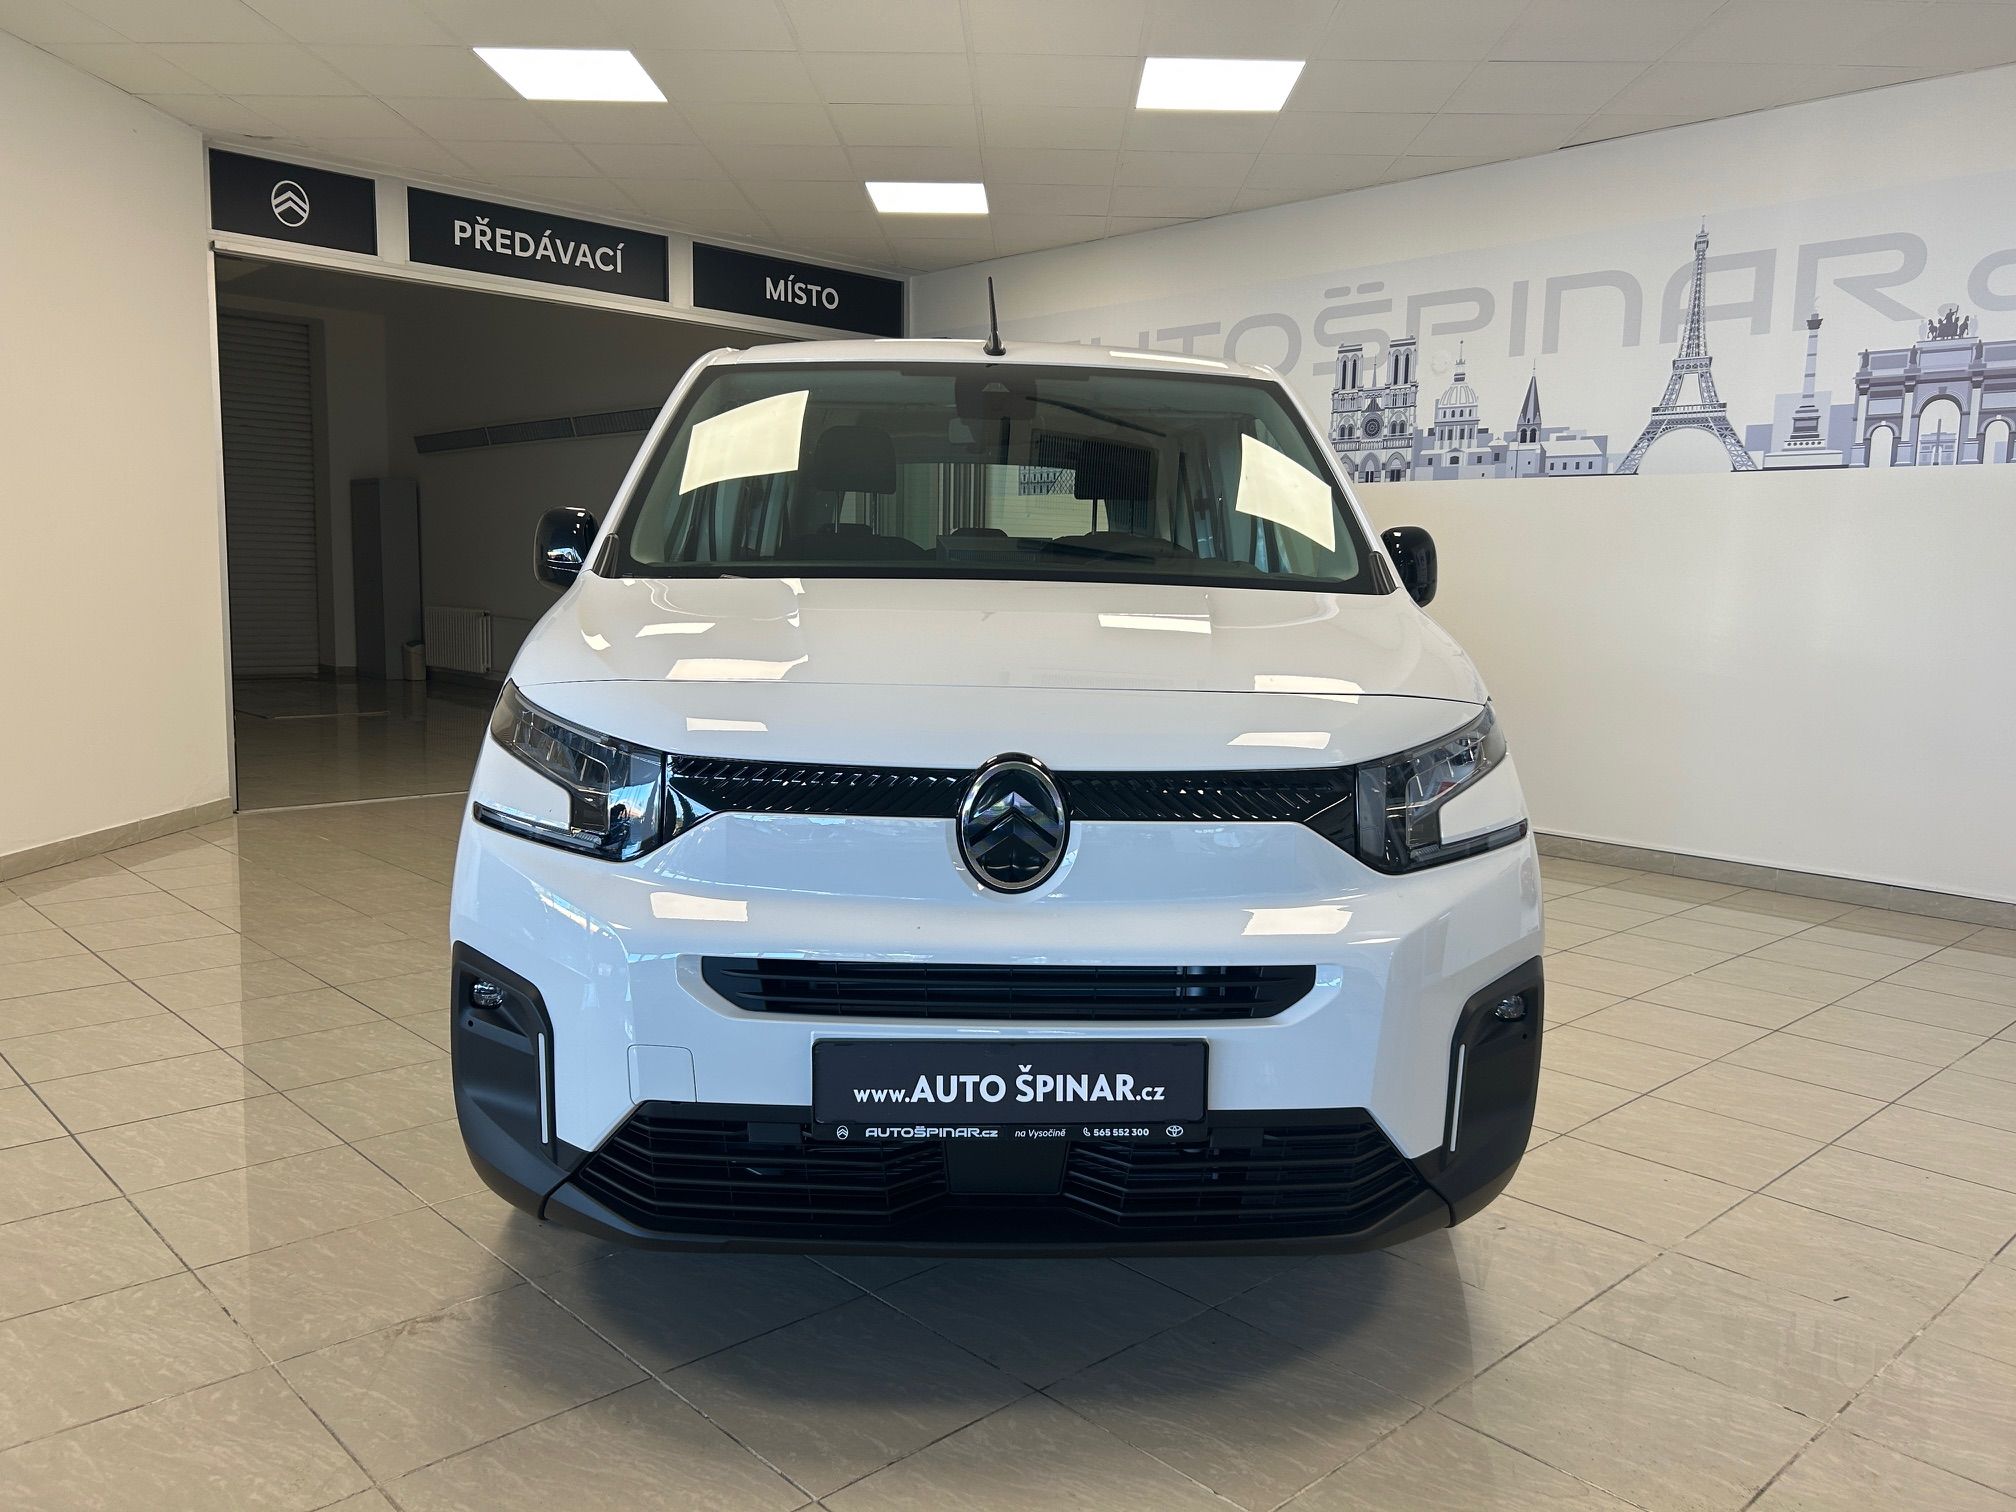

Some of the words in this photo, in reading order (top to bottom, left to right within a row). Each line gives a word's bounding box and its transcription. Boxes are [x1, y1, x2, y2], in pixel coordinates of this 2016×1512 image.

[453, 216, 624, 273] PŘEDÁVACÍ
[764, 275, 839, 310] MÍSTO
[853, 1074, 1007, 1103] www.AUTO
[1015, 1064, 1165, 1102] ŠPINAR.cz
[1014, 1129, 1026, 1138] na
[1028, 1128, 1066, 1139] Vysočině
[1093, 1128, 1111, 1137] 565
[1112, 1128, 1130, 1137] 552
[1131, 1128, 1150, 1137] 300
